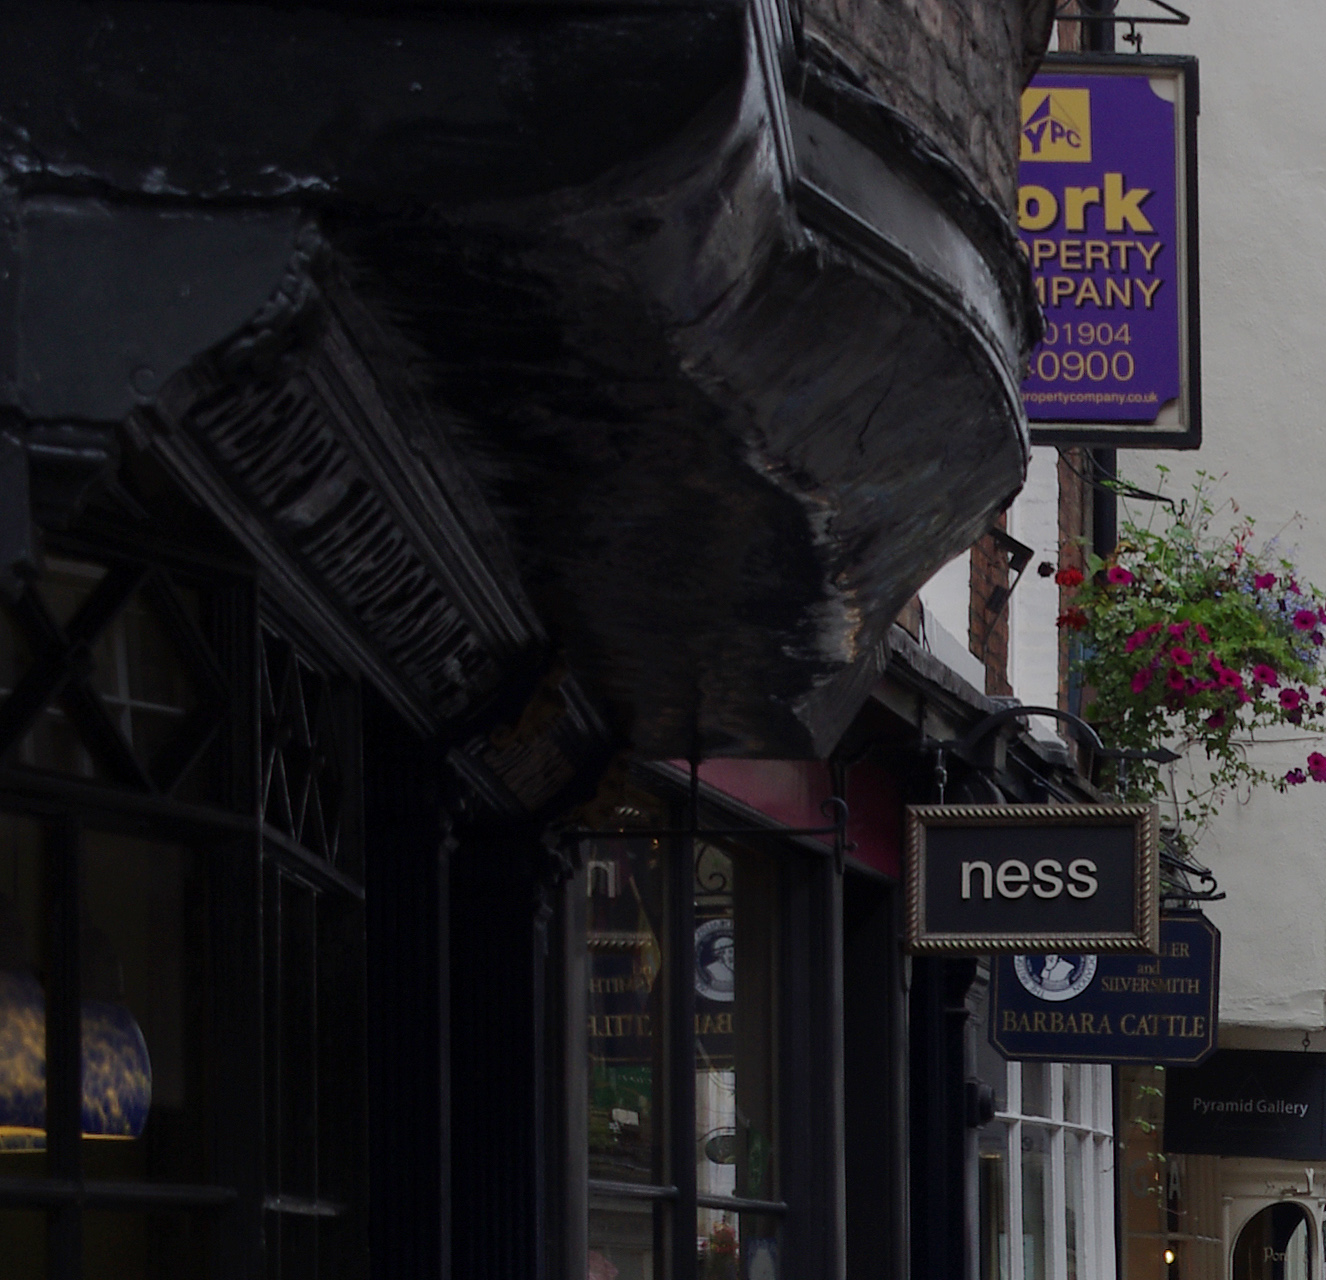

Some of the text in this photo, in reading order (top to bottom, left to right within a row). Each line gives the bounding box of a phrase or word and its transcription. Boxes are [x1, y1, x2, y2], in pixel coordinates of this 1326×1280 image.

[1018, 173, 1154, 231] ork
[1020, 239, 1162, 271] PERTY
[1035, 277, 1162, 307] PANY
[1043, 322, 1132, 345] 01904
[1027, 351, 1135, 381] 0900
[961, 858, 1098, 899] ness
[1137, 959, 1161, 974] and
[1101, 976, 1200, 994] SILVERSMITH
[1002, 1009, 1206, 1038] BARBARA CATTLE
[1193, 1098, 1309, 1118] Pyramid Gallery
